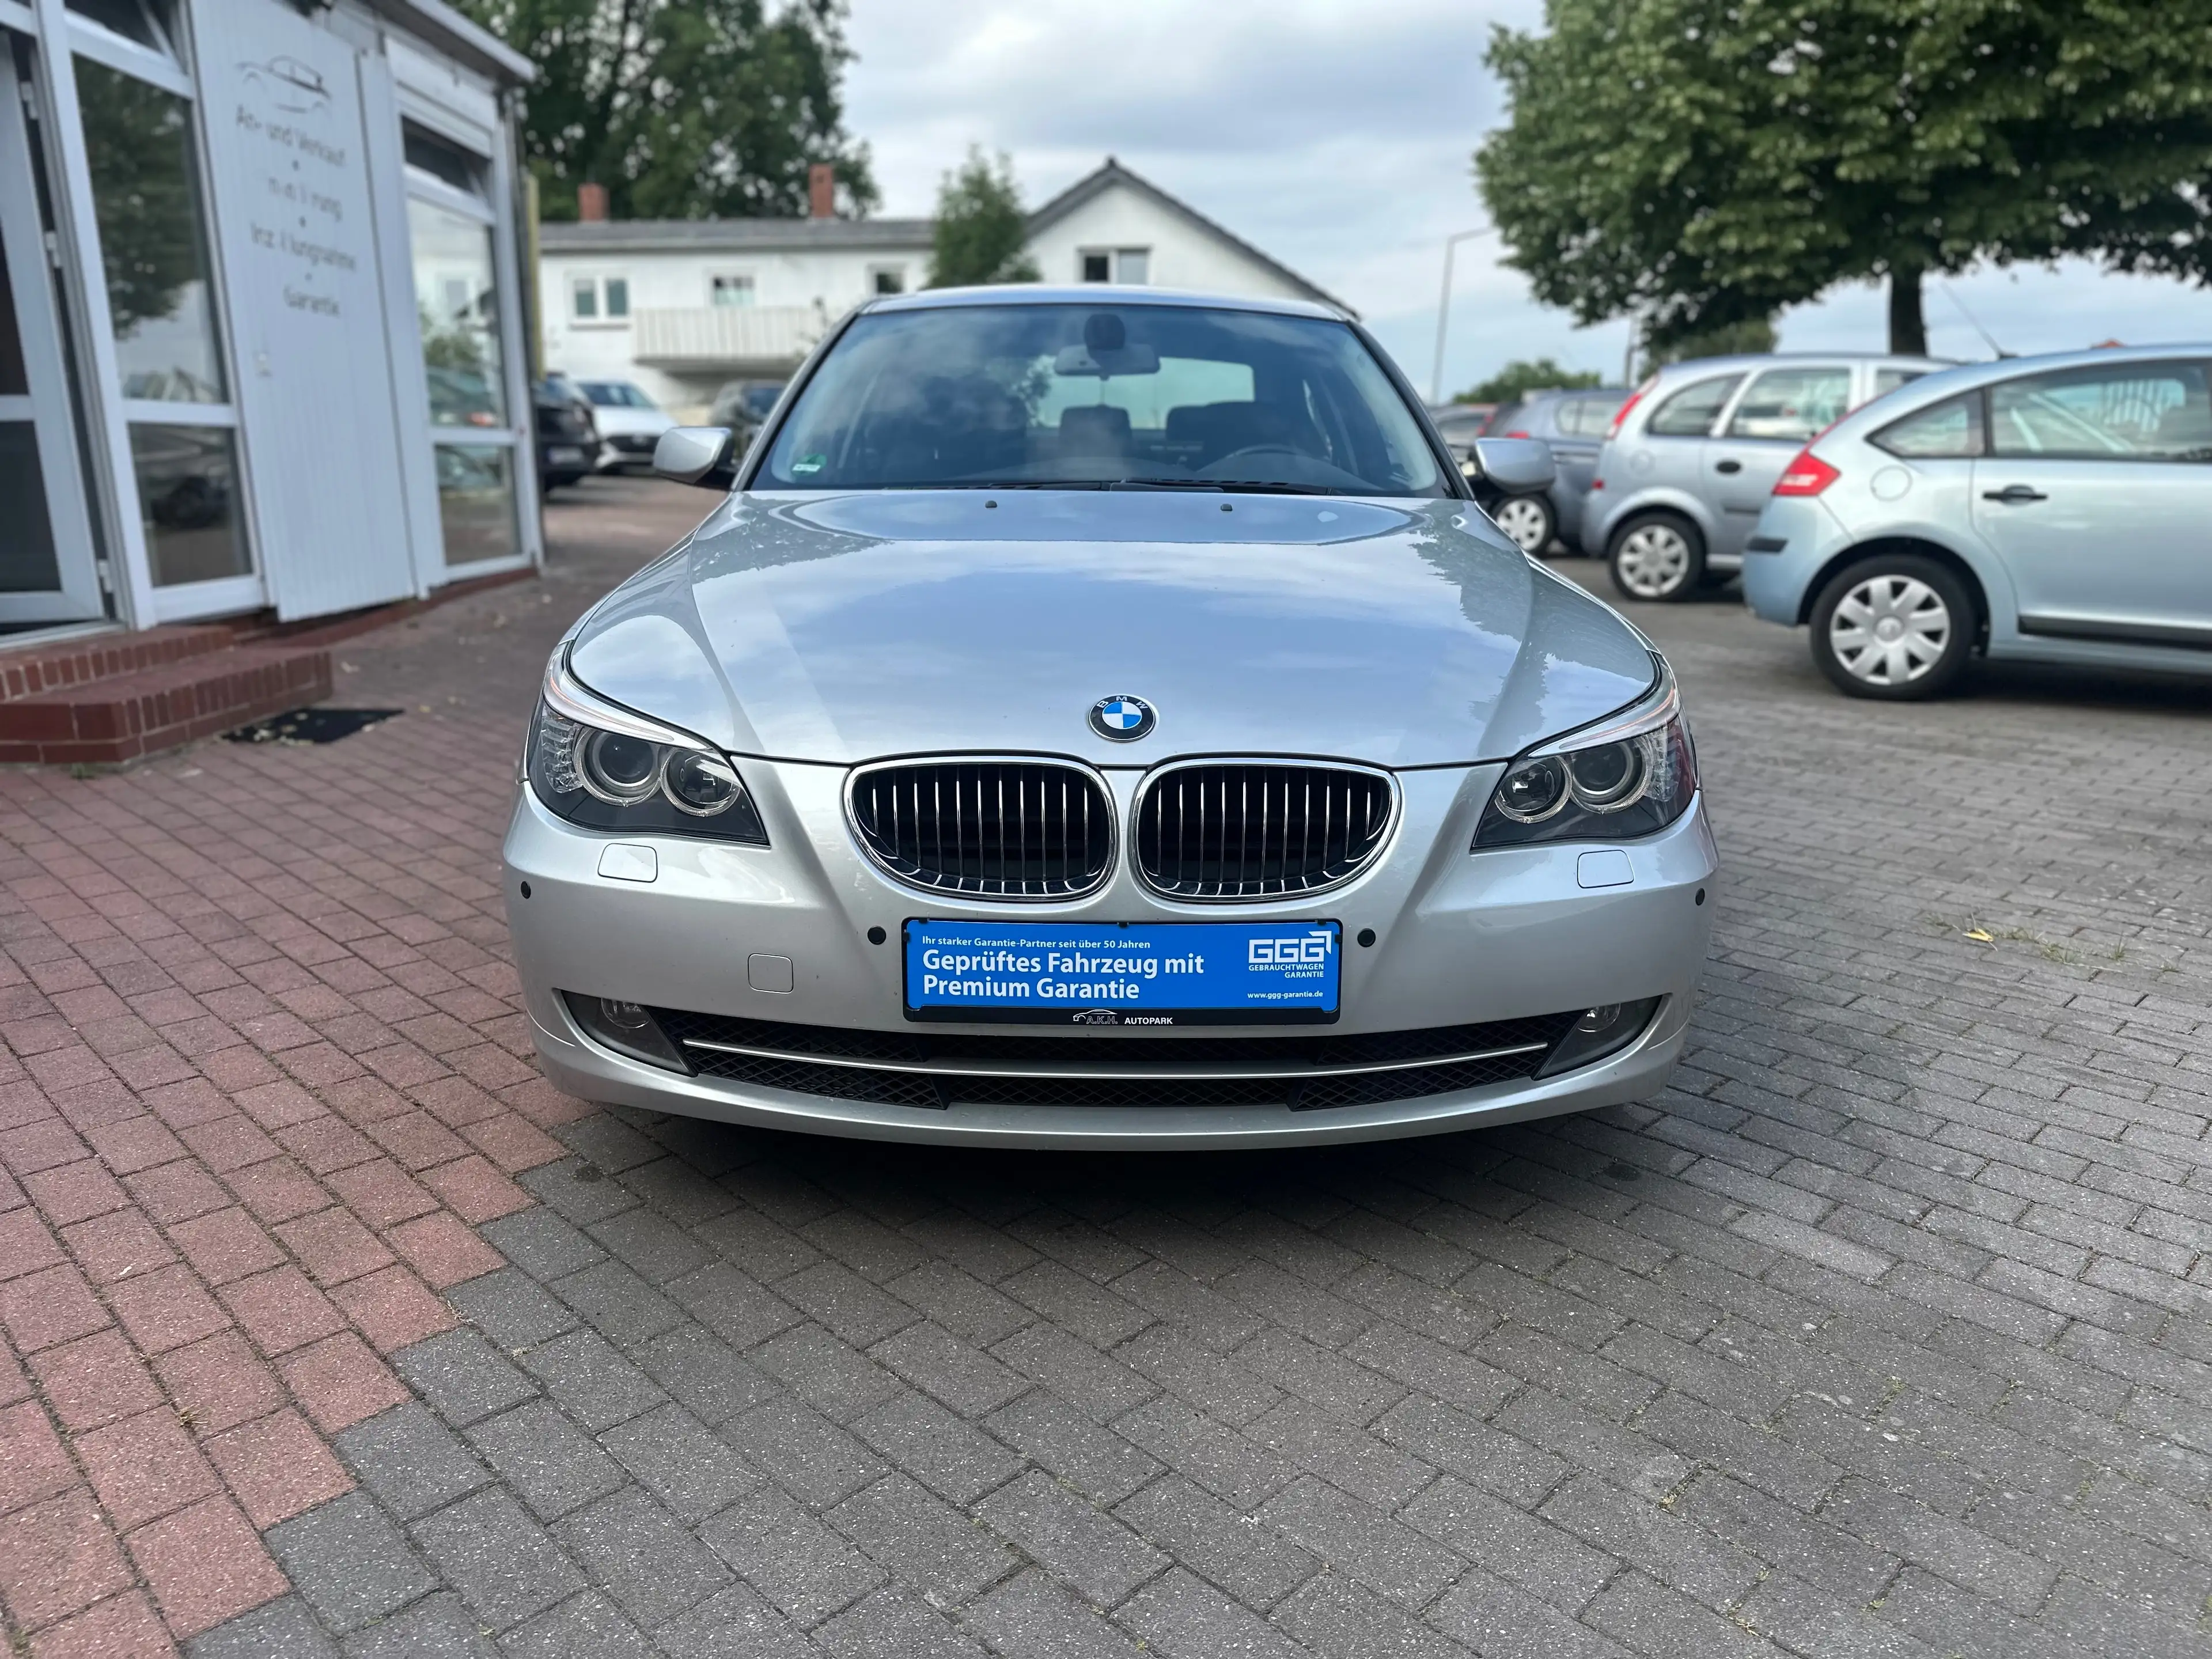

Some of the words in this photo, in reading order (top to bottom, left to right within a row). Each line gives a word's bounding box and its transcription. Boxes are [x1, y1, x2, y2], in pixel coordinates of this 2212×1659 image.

[1097, 696, 1148, 709] BMW
[922, 935, 935, 945] Ihr
[938, 937, 972, 946] starker
[974, 938, 1055, 948] Garantie-Partner
[1058, 940, 1076, 948] seit
[1078, 940, 1101, 948] über
[1104, 940, 1116, 948] 50
[1118, 940, 1150, 949] Jahren
[1248, 938, 1325, 963] GGG
[923, 949, 1041, 975] Geprüftes
[1048, 952, 1158, 979] Fahrzeug
[1165, 952, 1205, 974] mit
[1248, 963, 1324, 971] GEBRAUCHTWAGEN
[923, 974, 1030, 998] Premium
[1036, 978, 1139, 999] Garantie
[1247, 990, 1323, 999] www.ggg-garantie.de
[1086, 1016, 1118, 1024] A.K.H.
